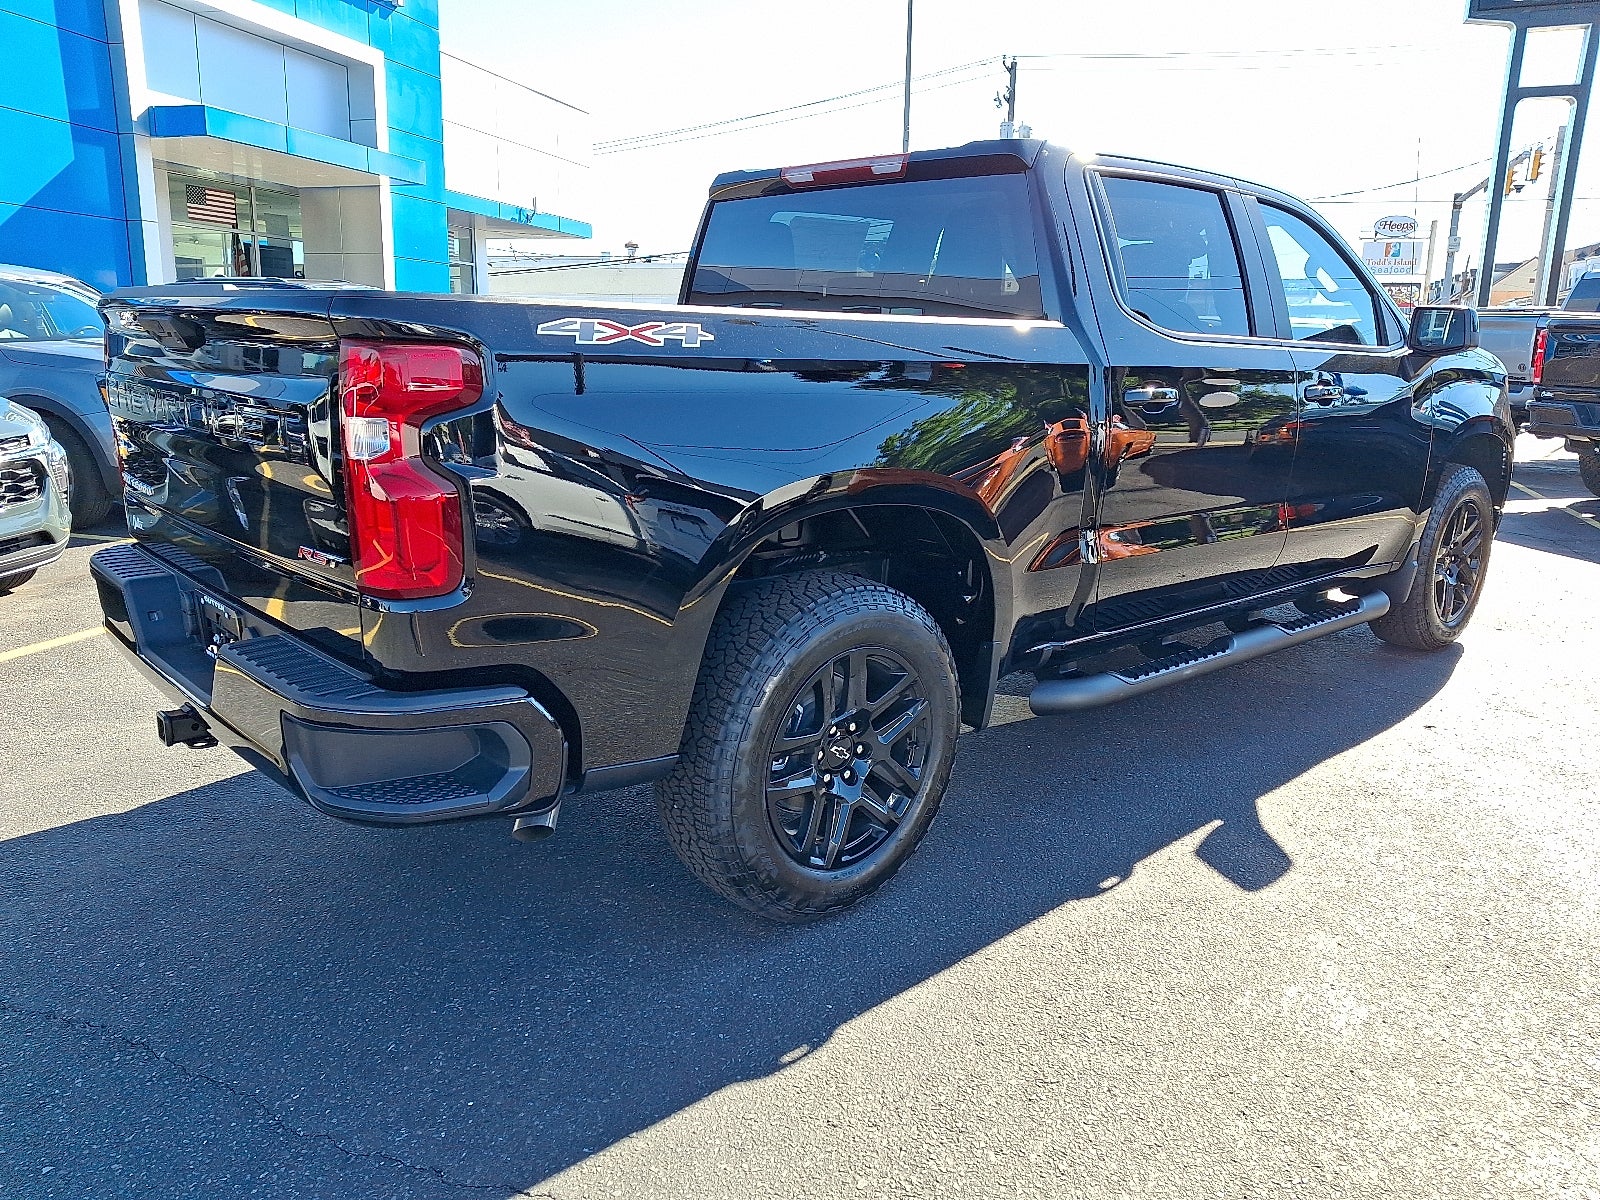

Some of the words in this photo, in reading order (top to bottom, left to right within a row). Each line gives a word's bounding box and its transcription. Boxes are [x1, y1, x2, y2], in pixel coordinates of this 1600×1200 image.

[1366, 258, 1392, 266] Todd's
[1393, 258, 1417, 266] Island
[1370, 266, 1412, 274] Seafood
[537, 317, 715, 348] 4X4
[297, 545, 345, 568] RST
